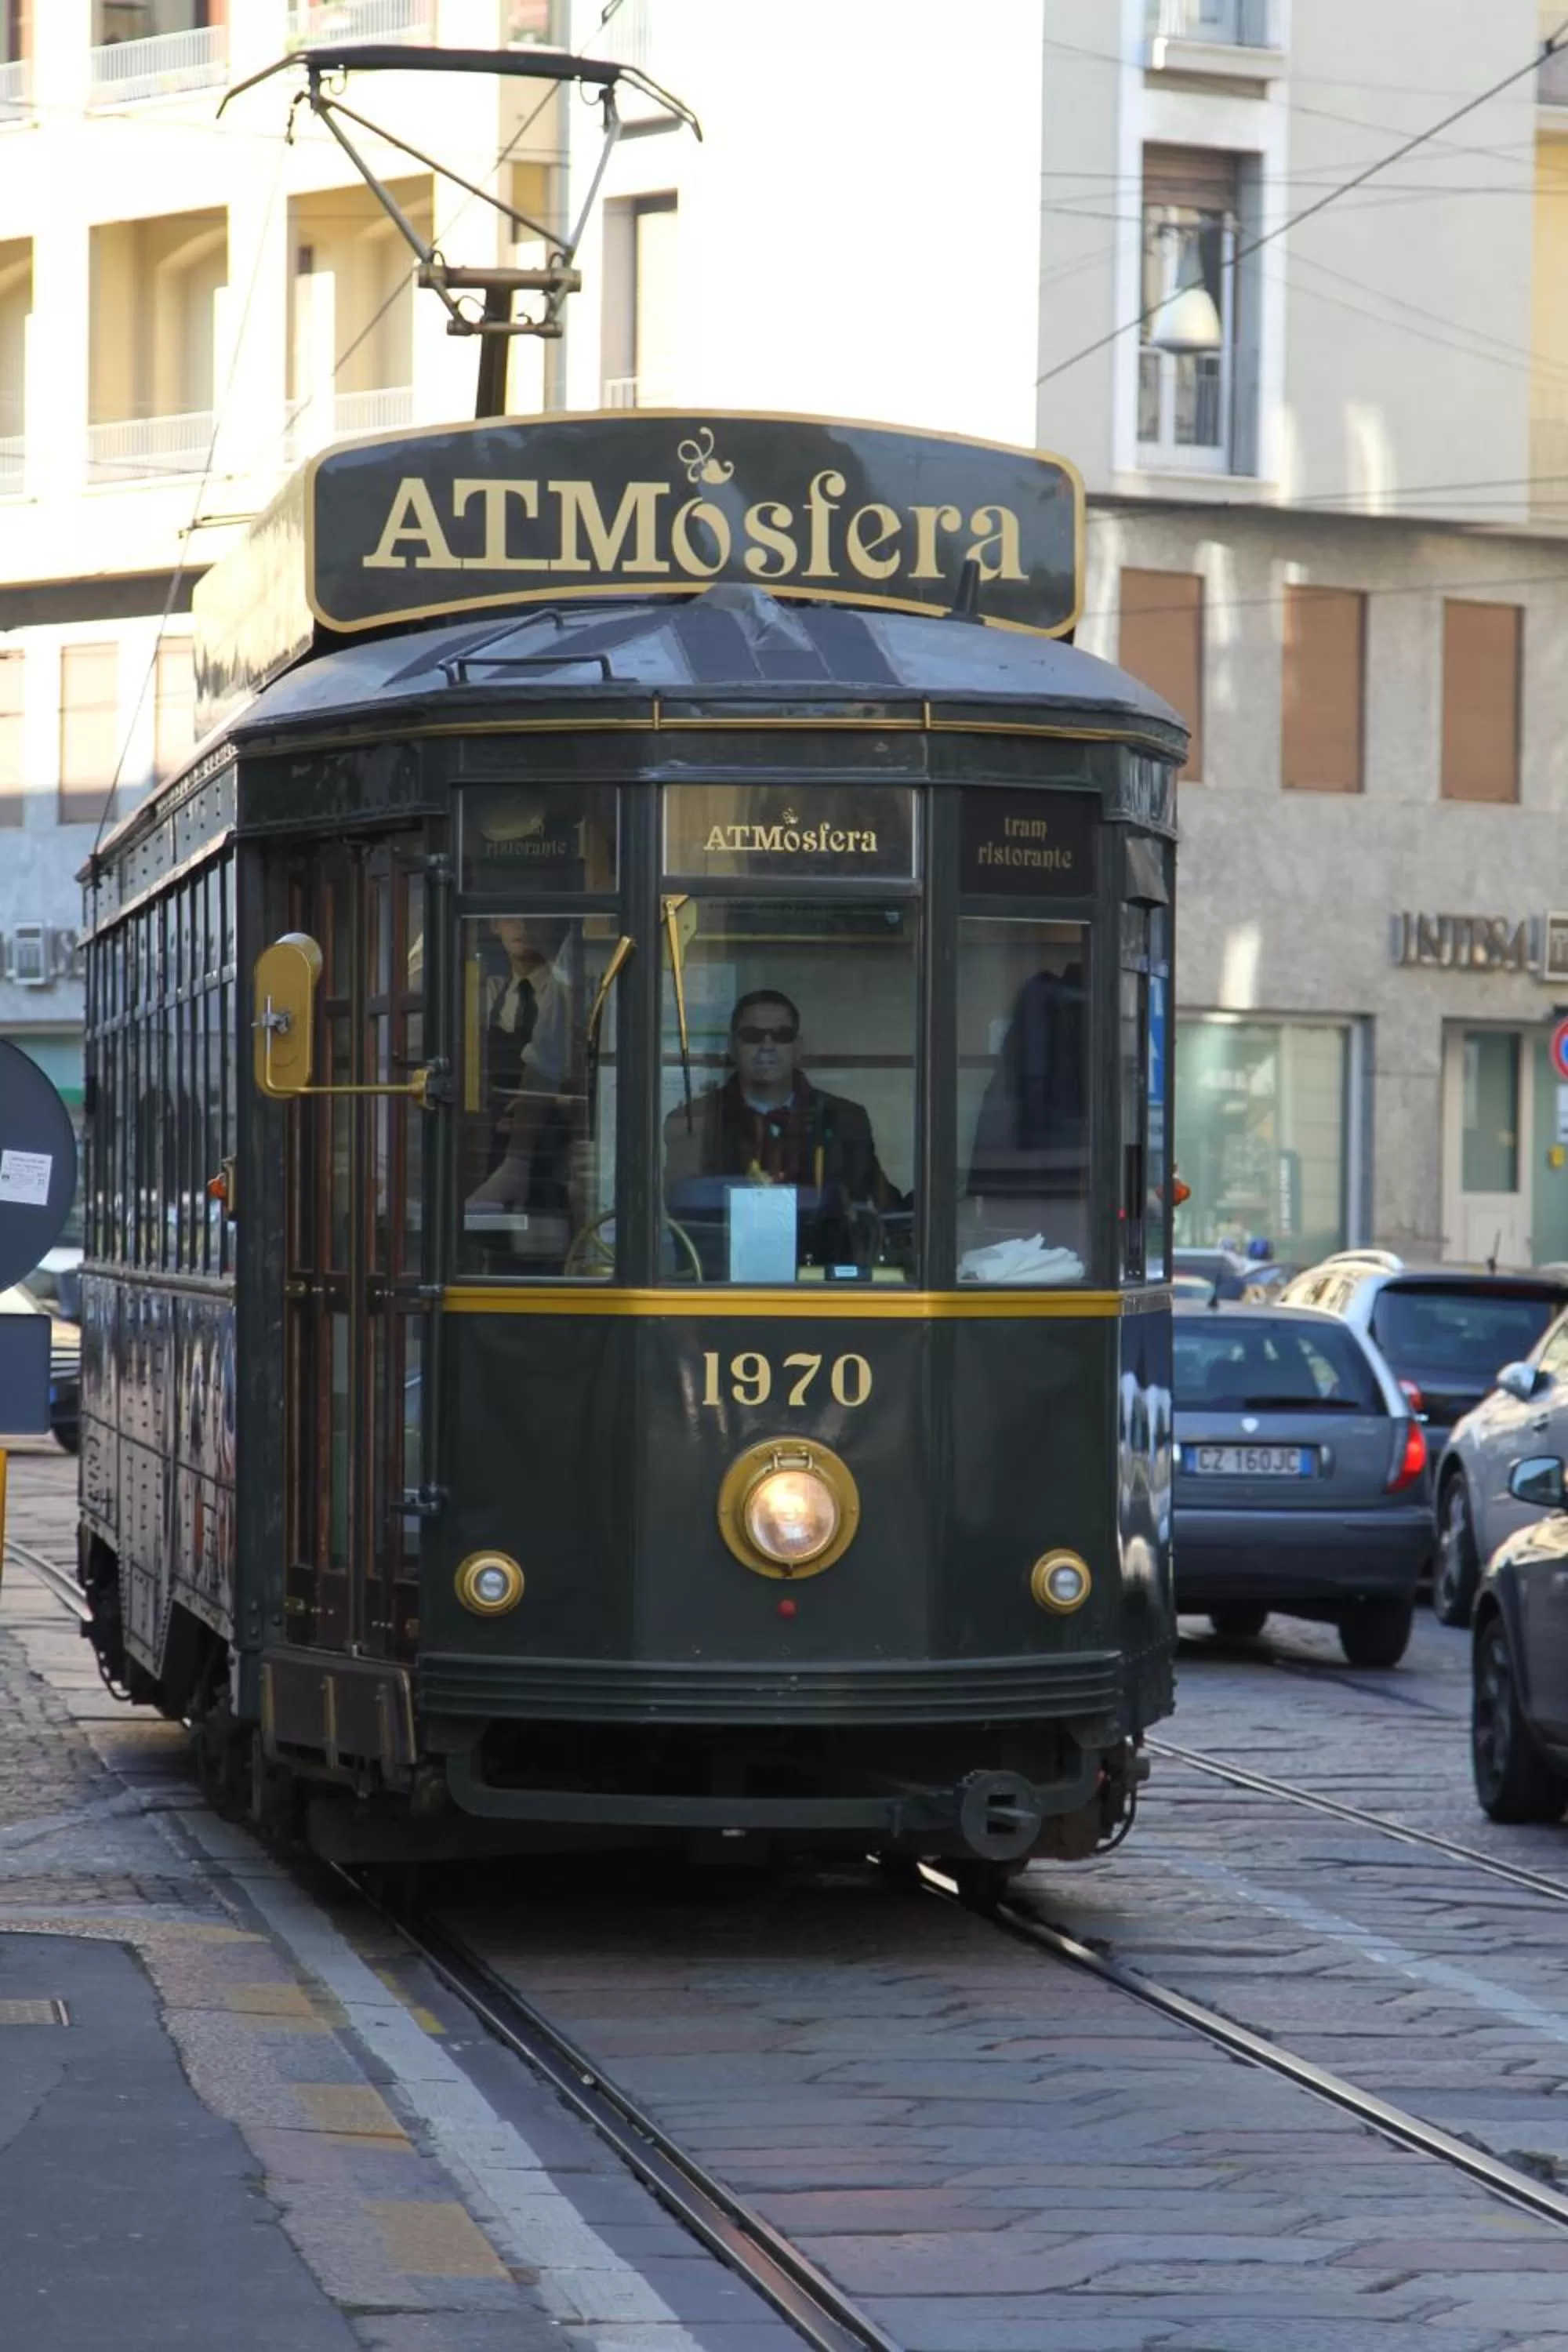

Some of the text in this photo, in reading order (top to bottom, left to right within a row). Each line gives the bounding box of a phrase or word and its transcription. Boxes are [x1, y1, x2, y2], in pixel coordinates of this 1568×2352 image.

[362, 470, 1029, 581] ATMosfera
[702, 821, 878, 852] ATMosfera
[1004, 815, 1048, 841] tram
[978, 840, 1073, 872] ristorante
[702, 1352, 873, 1407] 1970
